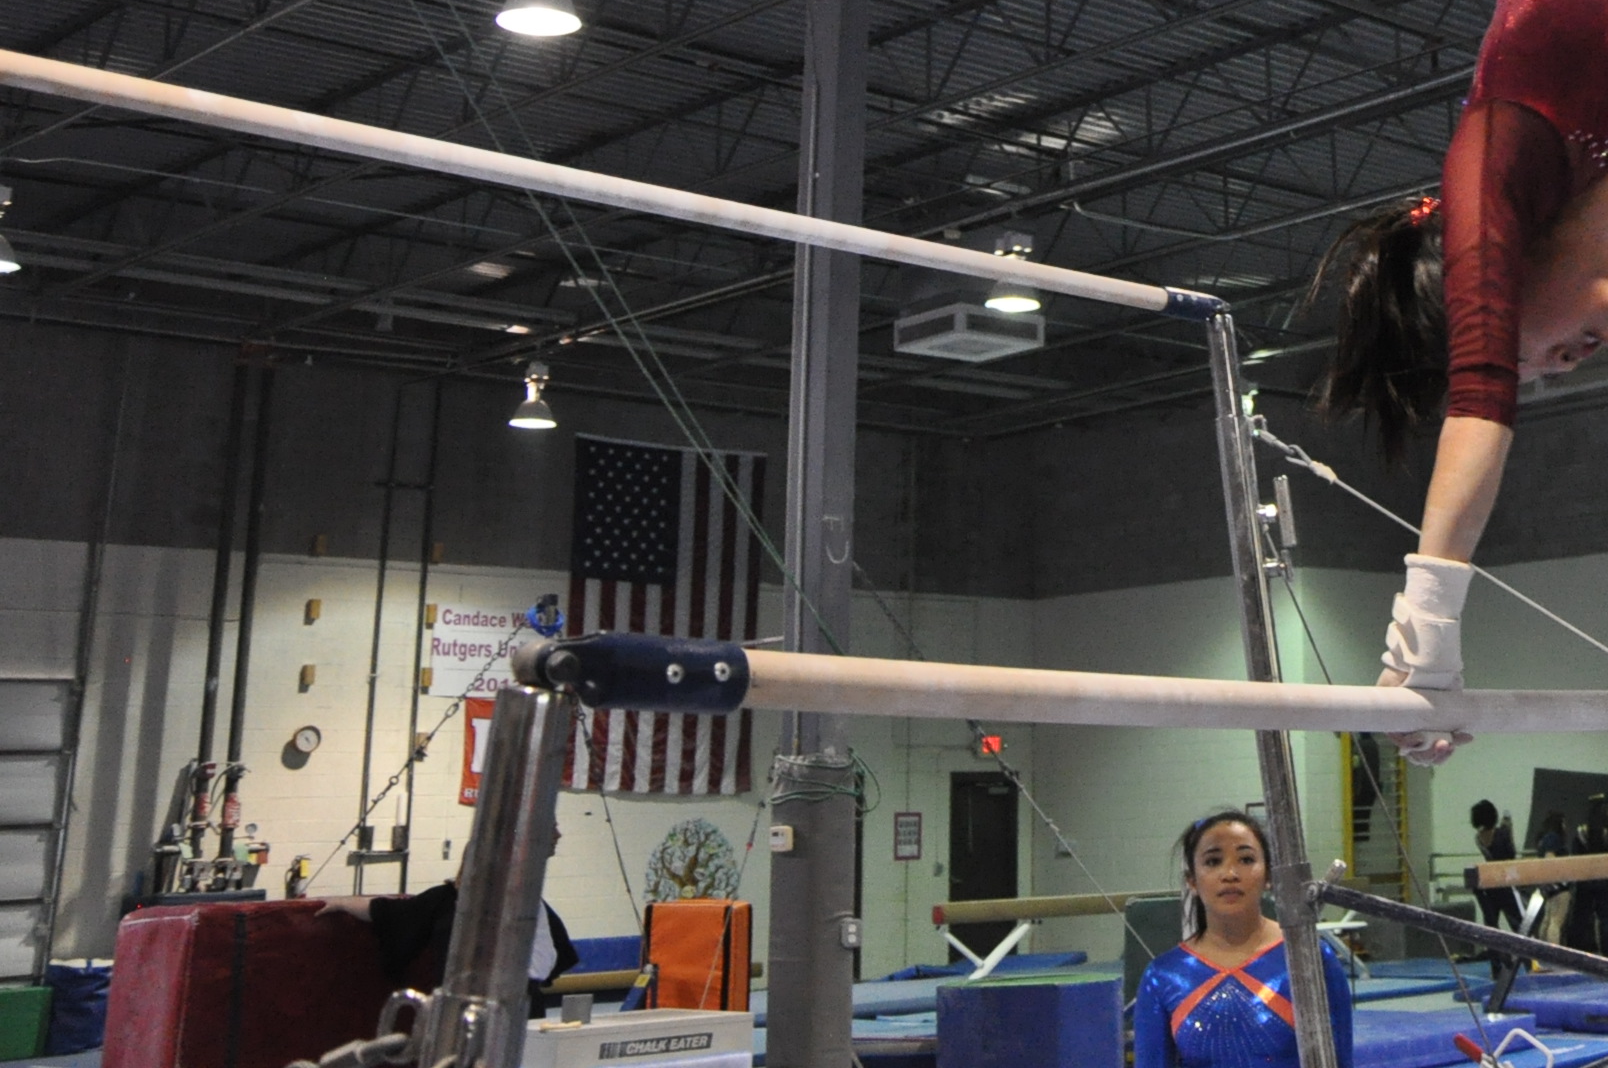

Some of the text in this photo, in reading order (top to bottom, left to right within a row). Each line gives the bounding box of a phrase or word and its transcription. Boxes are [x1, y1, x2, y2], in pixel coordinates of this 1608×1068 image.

[442, 608, 507, 628] Candace
[431, 637, 492, 662] Rutgers
[626, 1035, 708, 1055] CHALK EATER
